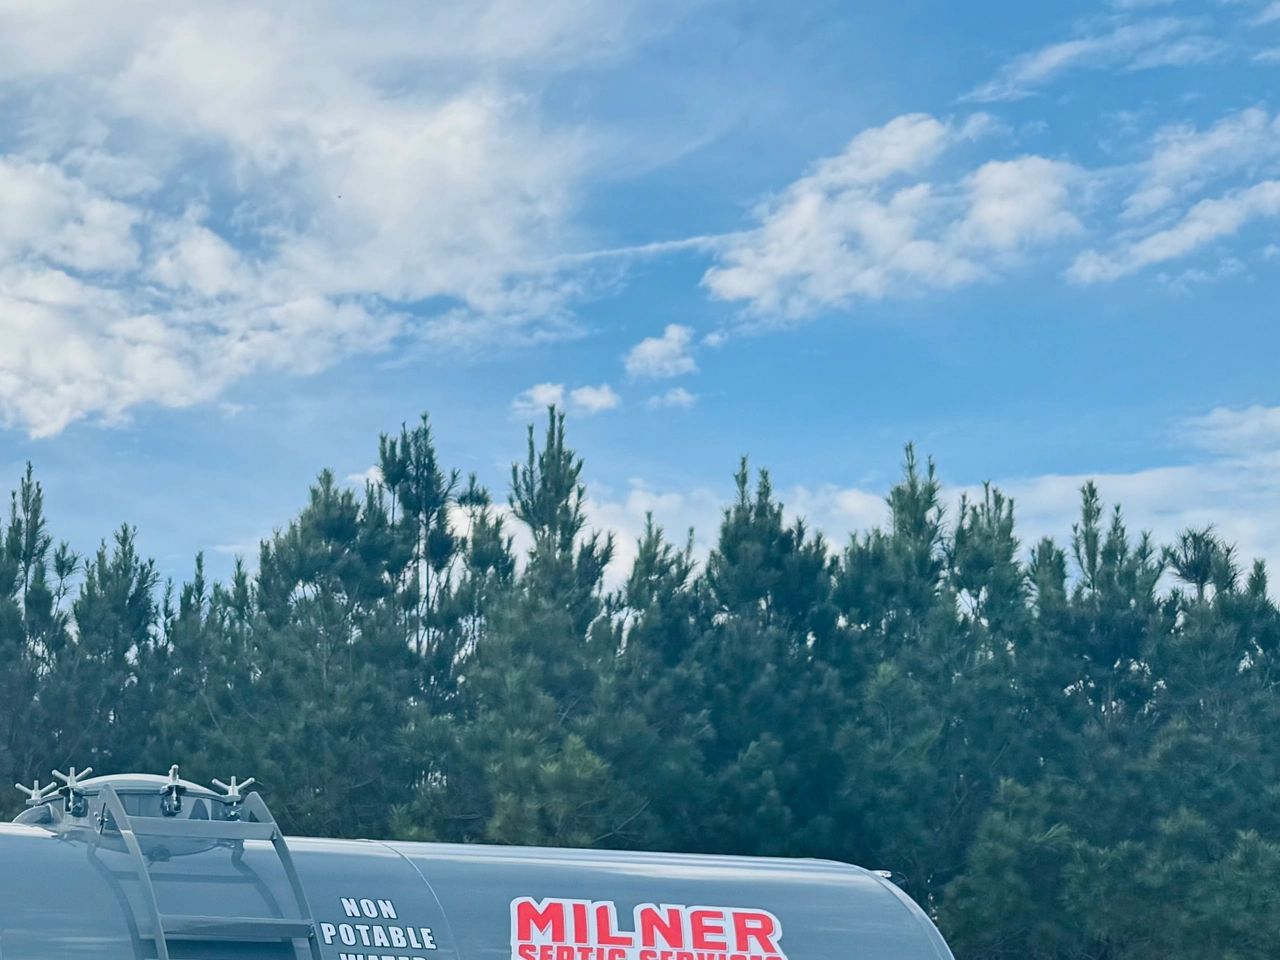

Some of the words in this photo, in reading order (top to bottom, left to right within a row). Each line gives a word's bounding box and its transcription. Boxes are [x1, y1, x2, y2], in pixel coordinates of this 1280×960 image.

[340, 897, 398, 921] NON
[320, 922, 437, 951] POTABLE
[515, 898, 778, 955] MILNER
